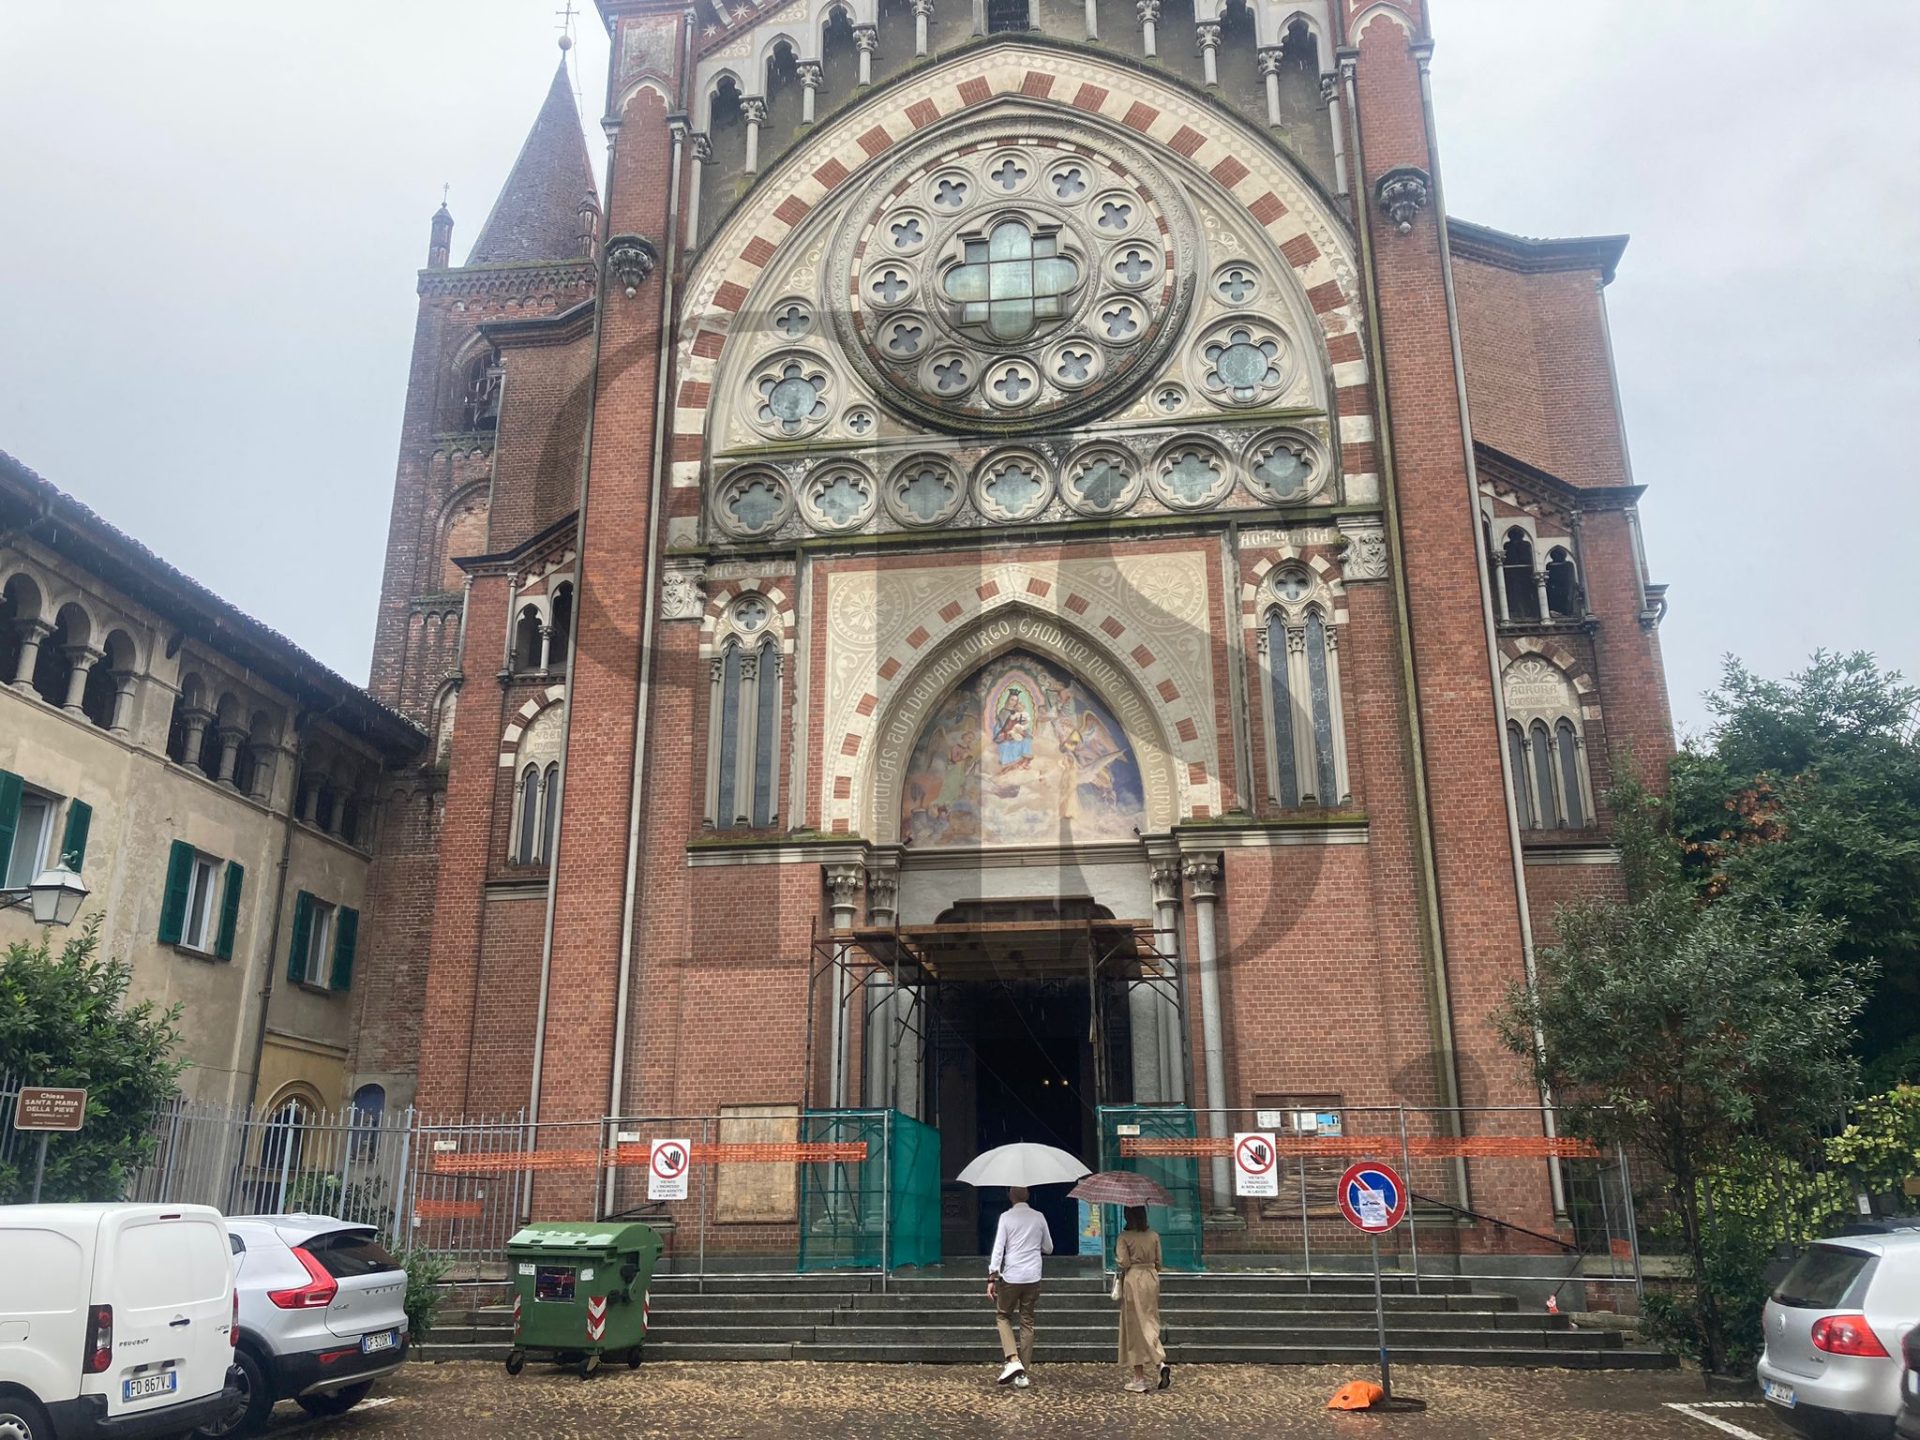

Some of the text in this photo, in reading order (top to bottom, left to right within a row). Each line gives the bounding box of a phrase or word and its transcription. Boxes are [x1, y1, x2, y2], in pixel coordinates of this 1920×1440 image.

[119, 1338, 149, 1347] PEUGEOT
[130, 1375, 172, 1396] FD 867VJ
